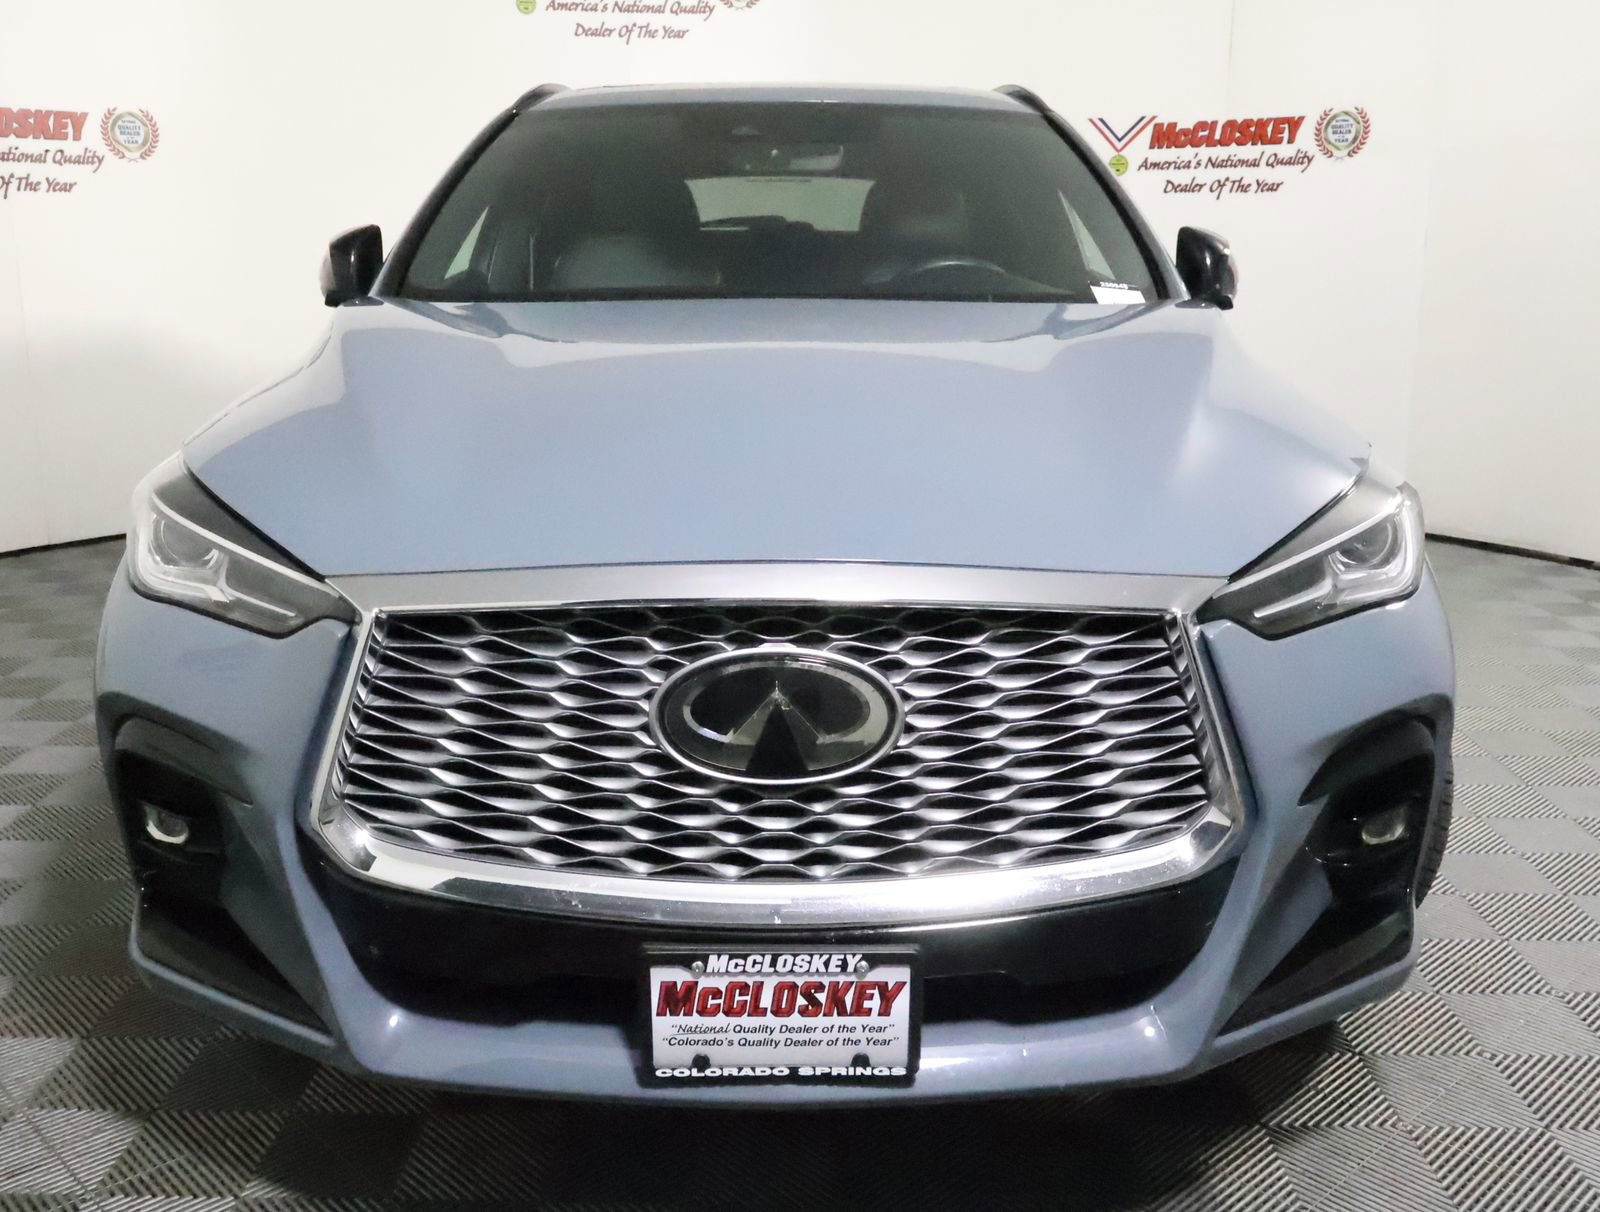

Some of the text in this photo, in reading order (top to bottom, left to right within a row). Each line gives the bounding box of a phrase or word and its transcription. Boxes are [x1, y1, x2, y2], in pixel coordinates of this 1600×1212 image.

[612, 0, 666, 14] National
[670, 1, 715, 21] Quality
[574, 21, 690, 45] Dealer Of The Year
[1149, 116, 1306, 150] McCLOSKEY
[52, 147, 104, 173] Quality
[1137, 148, 1315, 173] America's National Quality
[16, 173, 41, 192] The
[45, 177, 77, 193] Year
[1163, 176, 1284, 200] Dealer Of The Year
[706, 954, 863, 973] McCLOSKEY
[656, 980, 907, 1018] McCLOSKEY
[733, 1024, 776, 1036] Quality
[779, 1024, 818, 1034] Dealer
[821, 1024, 835, 1034] of
[837, 1024, 857, 1034] the
[738, 1037, 781, 1049] Quality
[784, 1037, 824, 1047] Dealer
[826, 1037, 840, 1047] of
[842, 1036, 861, 1046] the
[655, 1066, 907, 1077] COLORADO SPRINGS
